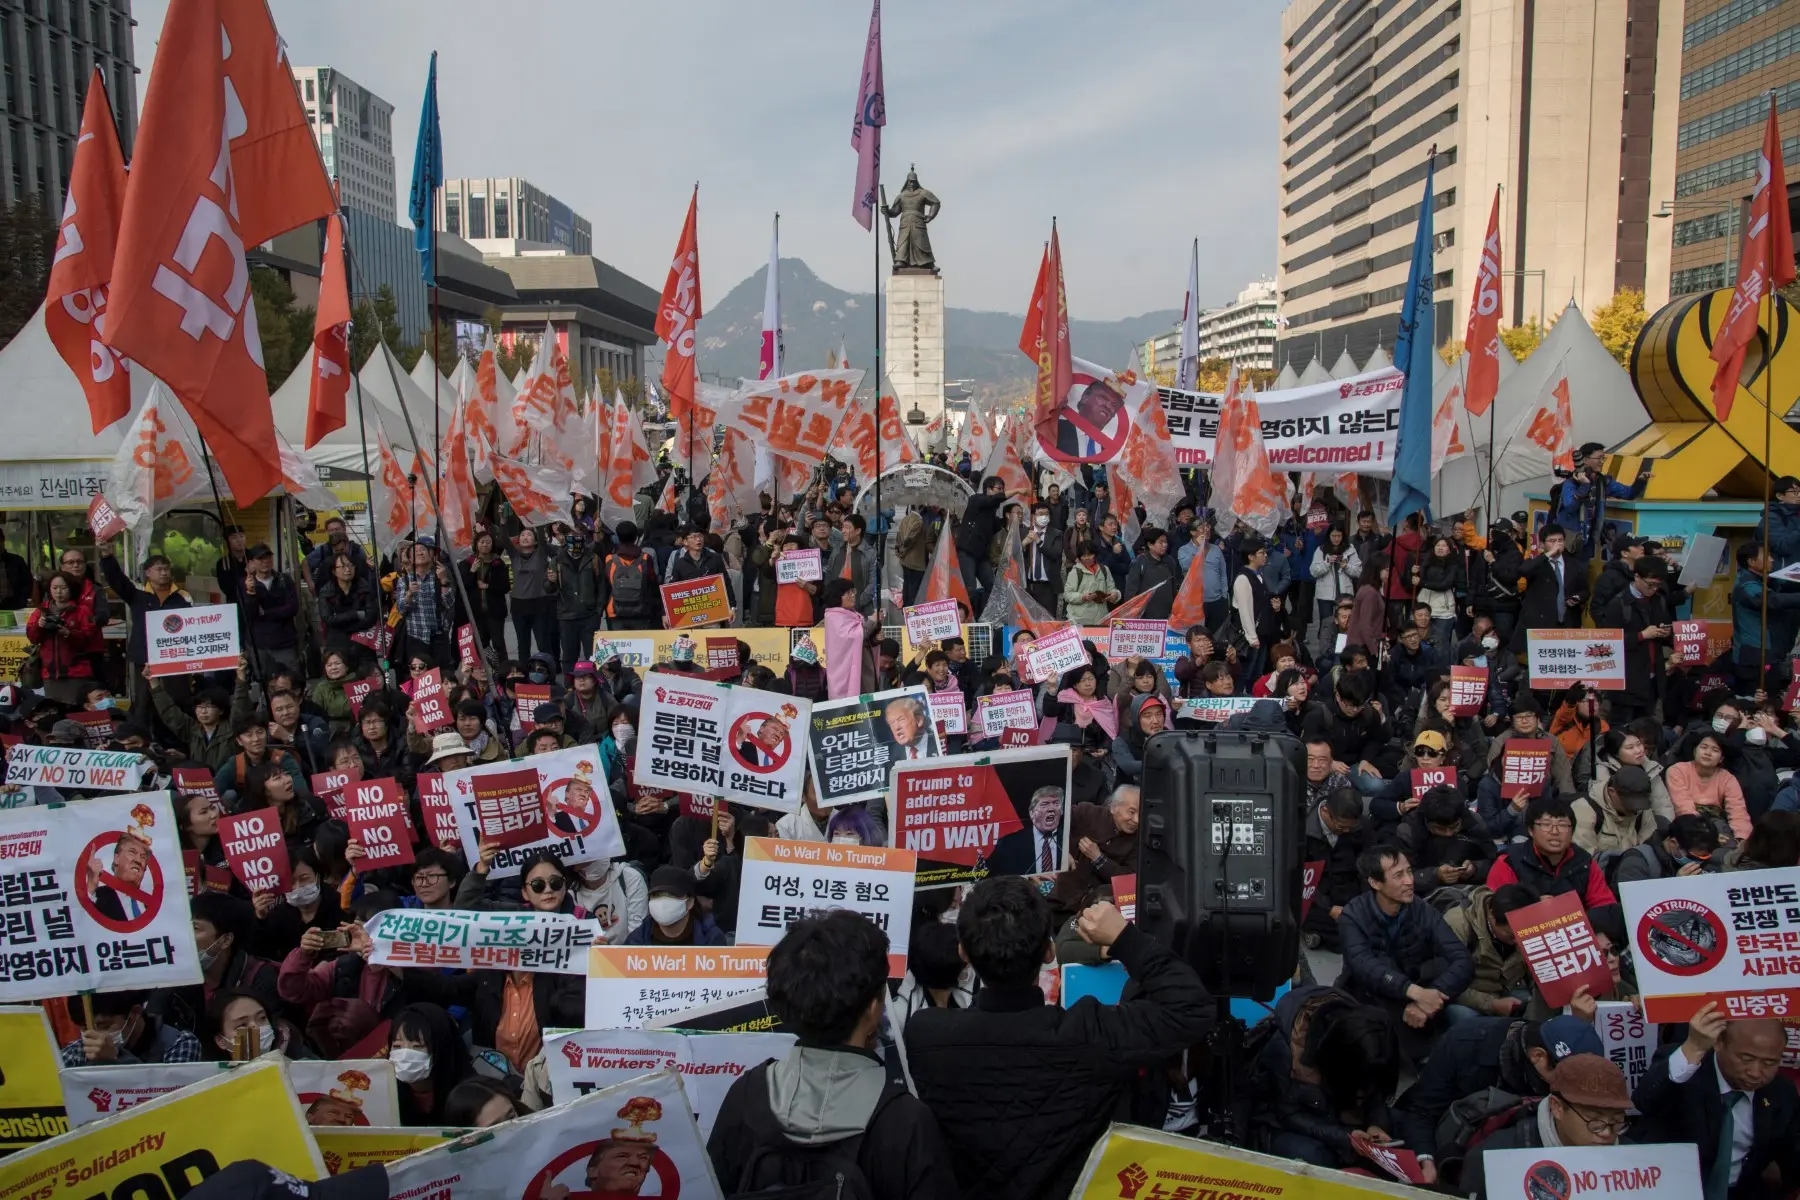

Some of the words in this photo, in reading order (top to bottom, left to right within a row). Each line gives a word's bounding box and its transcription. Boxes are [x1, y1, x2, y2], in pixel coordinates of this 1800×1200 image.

[1168, 415, 1191, 438] 린
[1261, 415, 1330, 440] 영하지
[1270, 441, 1371, 464] welcomed
[1675, 632, 1707, 642] TRUMP
[1682, 623, 1699, 633] NO
[159, 647, 195, 659] 트럼프는
[196, 643, 229, 657] 오지마라
[1683, 643, 1700, 654] NO
[353, 683, 370, 696] NO
[413, 683, 442, 701] TRUMP
[418, 674, 433, 689] NO
[1452, 680, 1486, 694] 트럼프
[421, 699, 439, 713] NO
[667, 695, 712, 711] 노동자연대
[422, 710, 444, 725] WAR
[654, 711, 723, 743] 트럼프,
[820, 731, 871, 754] 우리는
[1011, 732, 1030, 744] NO
[9, 748, 34, 764] SAY
[34, 748, 61, 765] NO
[62, 751, 83, 766] TO
[651, 733, 695, 760] 우린
[701, 741, 721, 766] 널
[1505, 756, 1547, 771] 트럼프
[7, 765, 39, 782] SAY
[39, 766, 66, 784] NO
[68, 768, 87, 785] TO
[89, 769, 126, 787] WAR
[326, 774, 349, 788] NO
[650, 757, 724, 788] 환영하지
[730, 772, 788, 800] 않는다
[828, 769, 887, 793] 환영하지
[906, 775, 953, 793] Trump
[957, 773, 974, 789] to
[1423, 771, 1446, 784] NO
[1504, 770, 1545, 785] 물러가
[357, 785, 385, 804] NO
[480, 793, 541, 818] 트럼프
[691, 795, 714, 808] NO
[905, 791, 966, 809] address
[349, 803, 399, 823] TRUMP
[482, 809, 543, 837] 물러가
[904, 805, 993, 828] parliament?
[232, 817, 265, 839] NO
[363, 826, 393, 845] NO
[905, 828, 937, 852] NO
[943, 821, 1000, 849] WAY!
[225, 831, 281, 856] TRUMP
[364, 843, 400, 860] WAR
[773, 844, 791, 858] No
[793, 845, 821, 861] War!
[826, 847, 843, 861] No
[846, 849, 887, 867] Trump!
[242, 857, 274, 879] NO
[245, 875, 280, 895] WAR
[764, 874, 805, 899] 여성,
[811, 877, 848, 901] 인종
[854, 880, 890, 902] 혐오
[1727, 883, 1797, 908] 한반도
[1646, 902, 1664, 921] NO
[1662, 900, 1709, 918] TRUMP!
[1732, 908, 1780, 932] 전쟁
[42, 904, 75, 941] 널
[377, 913, 469, 948] 전쟁위기
[475, 924, 595, 949] 고조시키는
[1521, 920, 1594, 962] 트럼프
[96, 935, 176, 973] 않는다
[386, 941, 464, 965] 트럼프
[469, 947, 571, 970] 반대한다!
[627, 955, 648, 972] No
[650, 954, 687, 973] War!
[695, 954, 716, 972] No
[1531, 947, 1603, 984] 물러가
[1726, 993, 1791, 1018] 민중당
[586, 1046, 677, 1059] www.workerssolidarity.org
[587, 1055, 661, 1070] Workers'
[664, 1059, 747, 1077] Solidarity
[64, 1131, 166, 1189] Solidarity
[1156, 1169, 1284, 1197] www.workerssolidarity.org
[1572, 1170, 1598, 1195] NO
[1599, 1165, 1662, 1193] TRUMP
